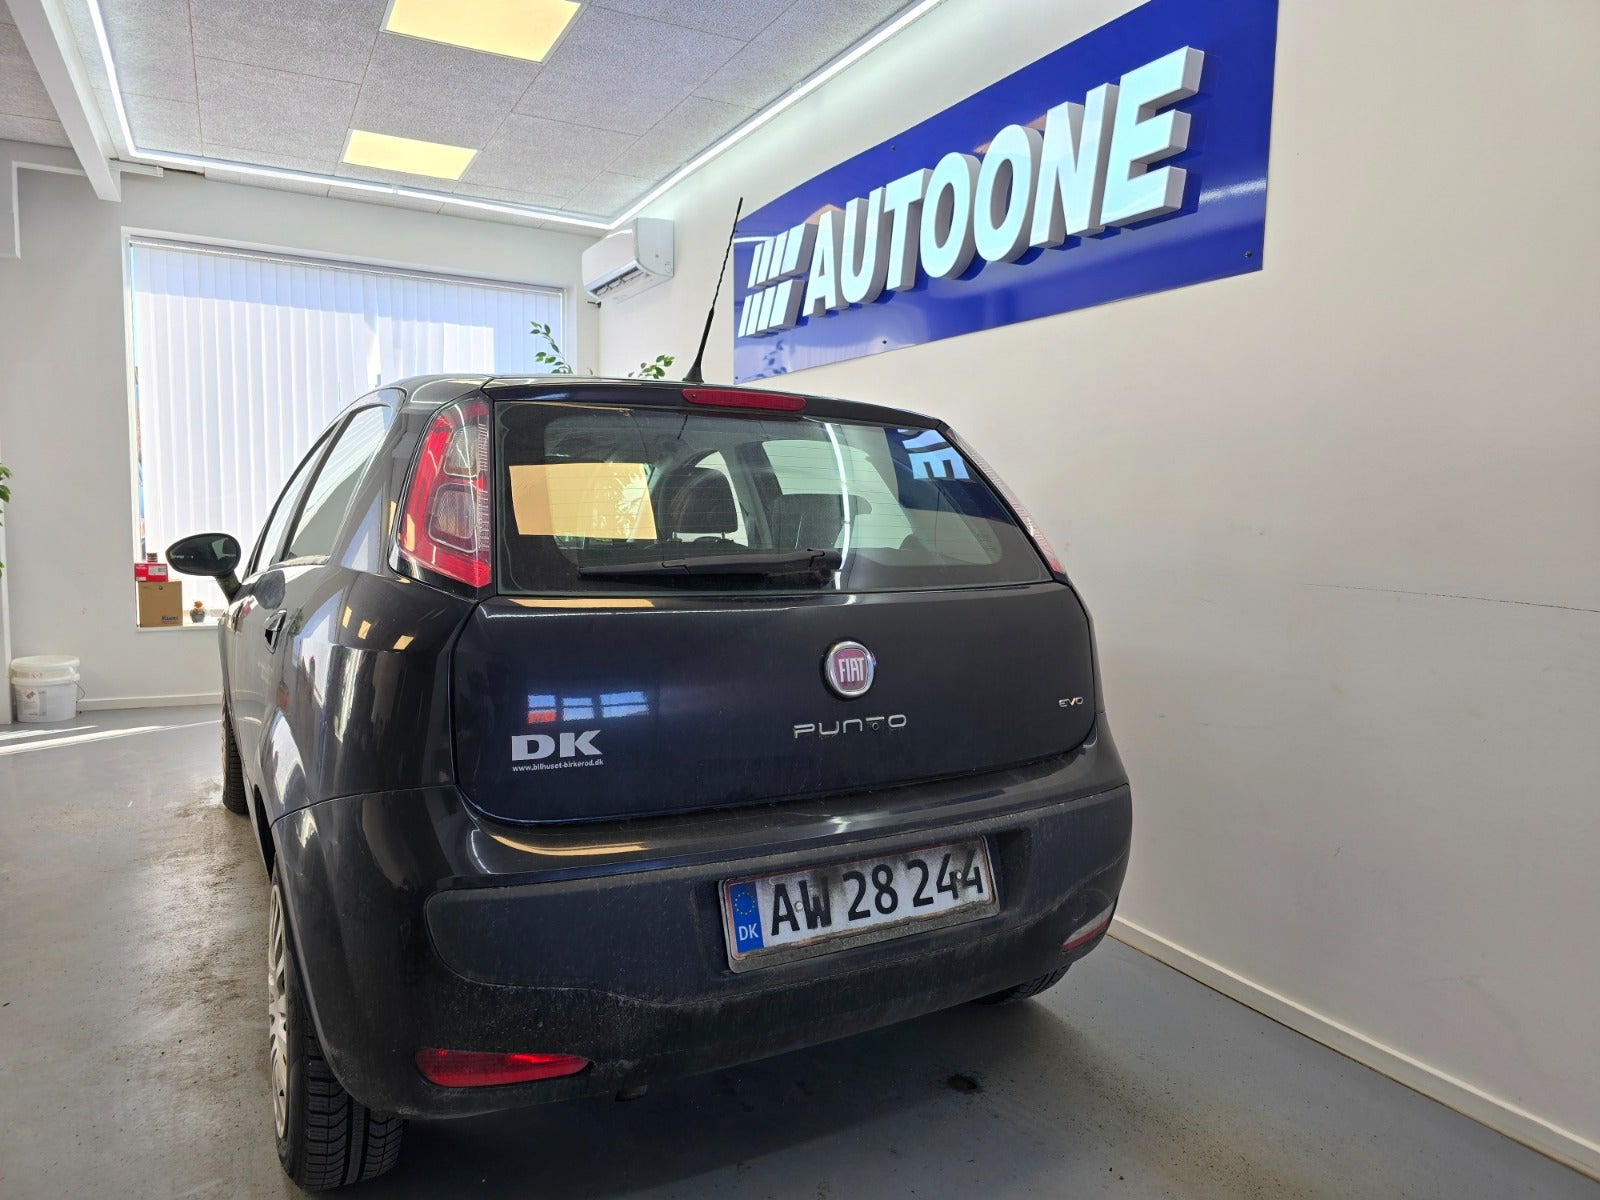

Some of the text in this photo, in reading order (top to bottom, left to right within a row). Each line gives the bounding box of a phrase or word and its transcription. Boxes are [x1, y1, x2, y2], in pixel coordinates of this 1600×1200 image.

[802, 45, 1204, 318] AUTOONE
[838, 656, 865, 683] FIAT
[1058, 696, 1084, 708] EVO
[793, 713, 908, 739] PUNTO
[511, 729, 603, 761] DK
[771, 879, 832, 936] AW
[843, 863, 899, 922] 28
[906, 850, 984, 908] 244
[738, 923, 760, 942] DK
